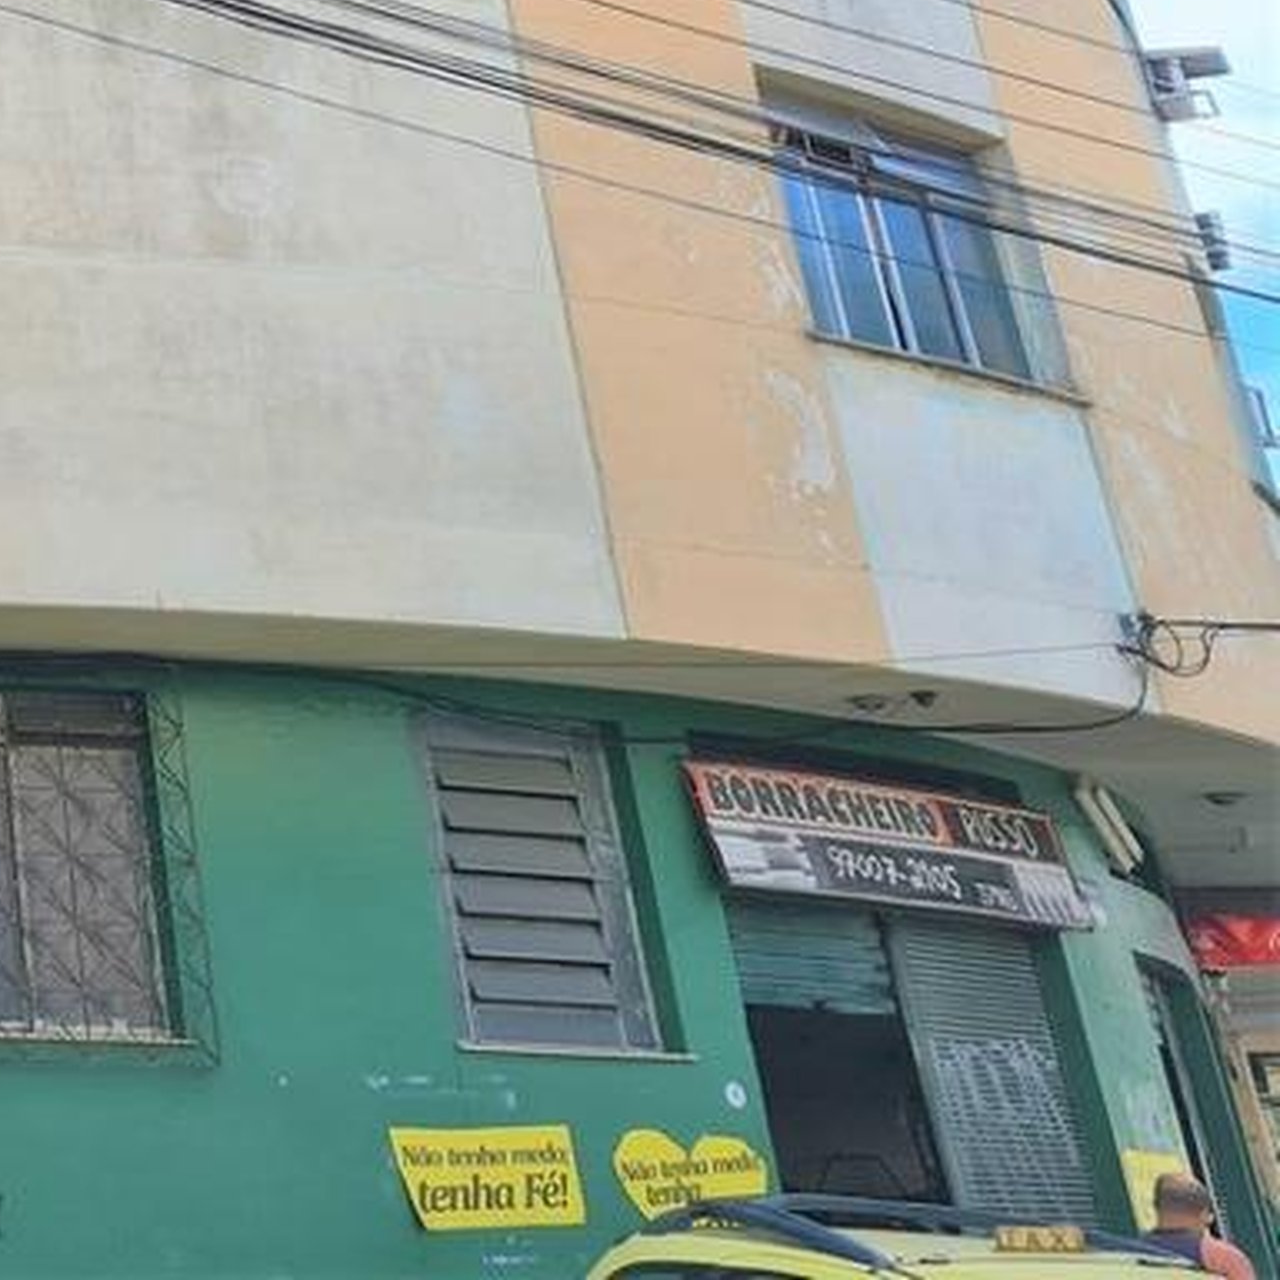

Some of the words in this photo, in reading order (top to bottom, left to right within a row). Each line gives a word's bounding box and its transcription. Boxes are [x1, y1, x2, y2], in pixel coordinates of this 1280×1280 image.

[705, 771, 939, 838] BORRACHEIRO
[402, 1145, 443, 1167] Não
[447, 1144, 508, 1167] tenha
[419, 1173, 516, 1215] tenha
[524, 1170, 569, 1210] Fé!
